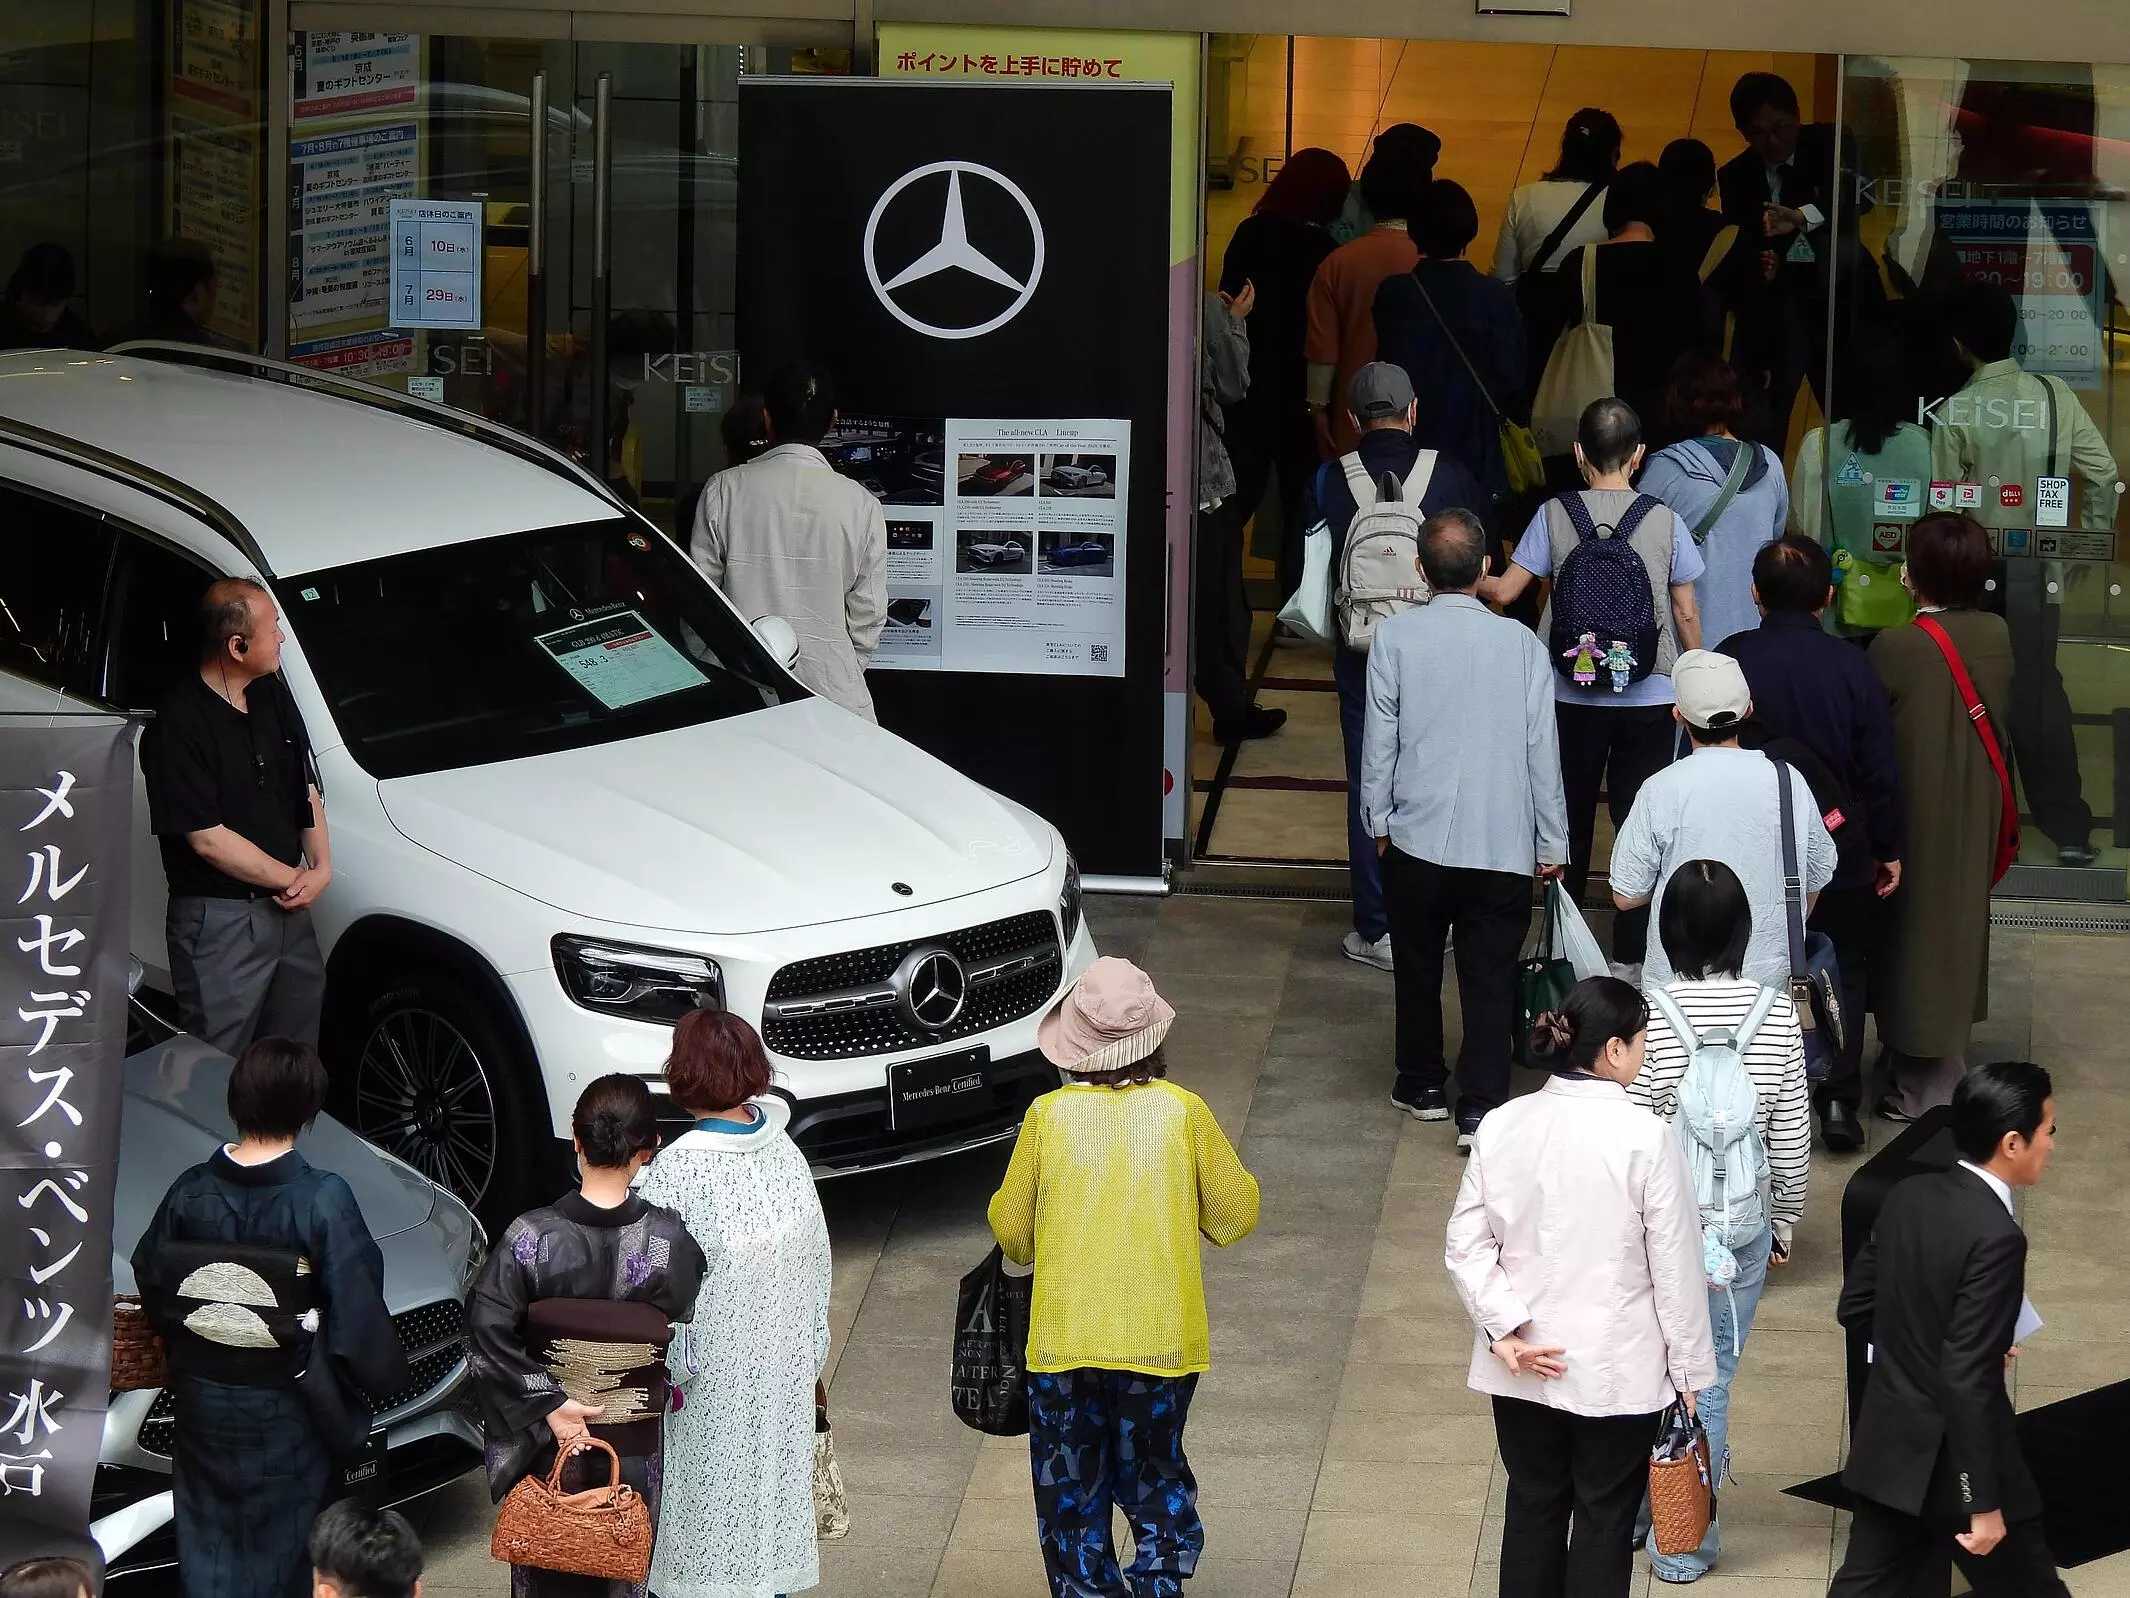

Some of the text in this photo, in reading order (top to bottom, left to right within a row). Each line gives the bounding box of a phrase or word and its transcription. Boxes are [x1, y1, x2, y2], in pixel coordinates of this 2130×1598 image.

[355, 62, 372, 73] 京成
[897, 52, 1123, 78] ポイントを上手に貯めて
[316, 73, 391, 92] 夏のギフトセンター
[419, 209, 473, 220] 店休日のご案内
[404, 235, 414, 257] 6月
[404, 284, 414, 306] 7月
[998, 428, 1009, 436] The
[1034, 428, 1048, 436] CLA
[1056, 428, 1079, 438] Lineup
[2040, 480, 2066, 489] SHOP
[2040, 489, 2059, 498] TAX
[2039, 499, 2063, 508] FREE
[1879, 531, 1897, 539] AED
[902, 1075, 981, 1103] Mercedes-Benz Certified
[0, 770, 92, 1497] メルセデス・ベンツ 水戸
[962, 1281, 997, 1334] A
